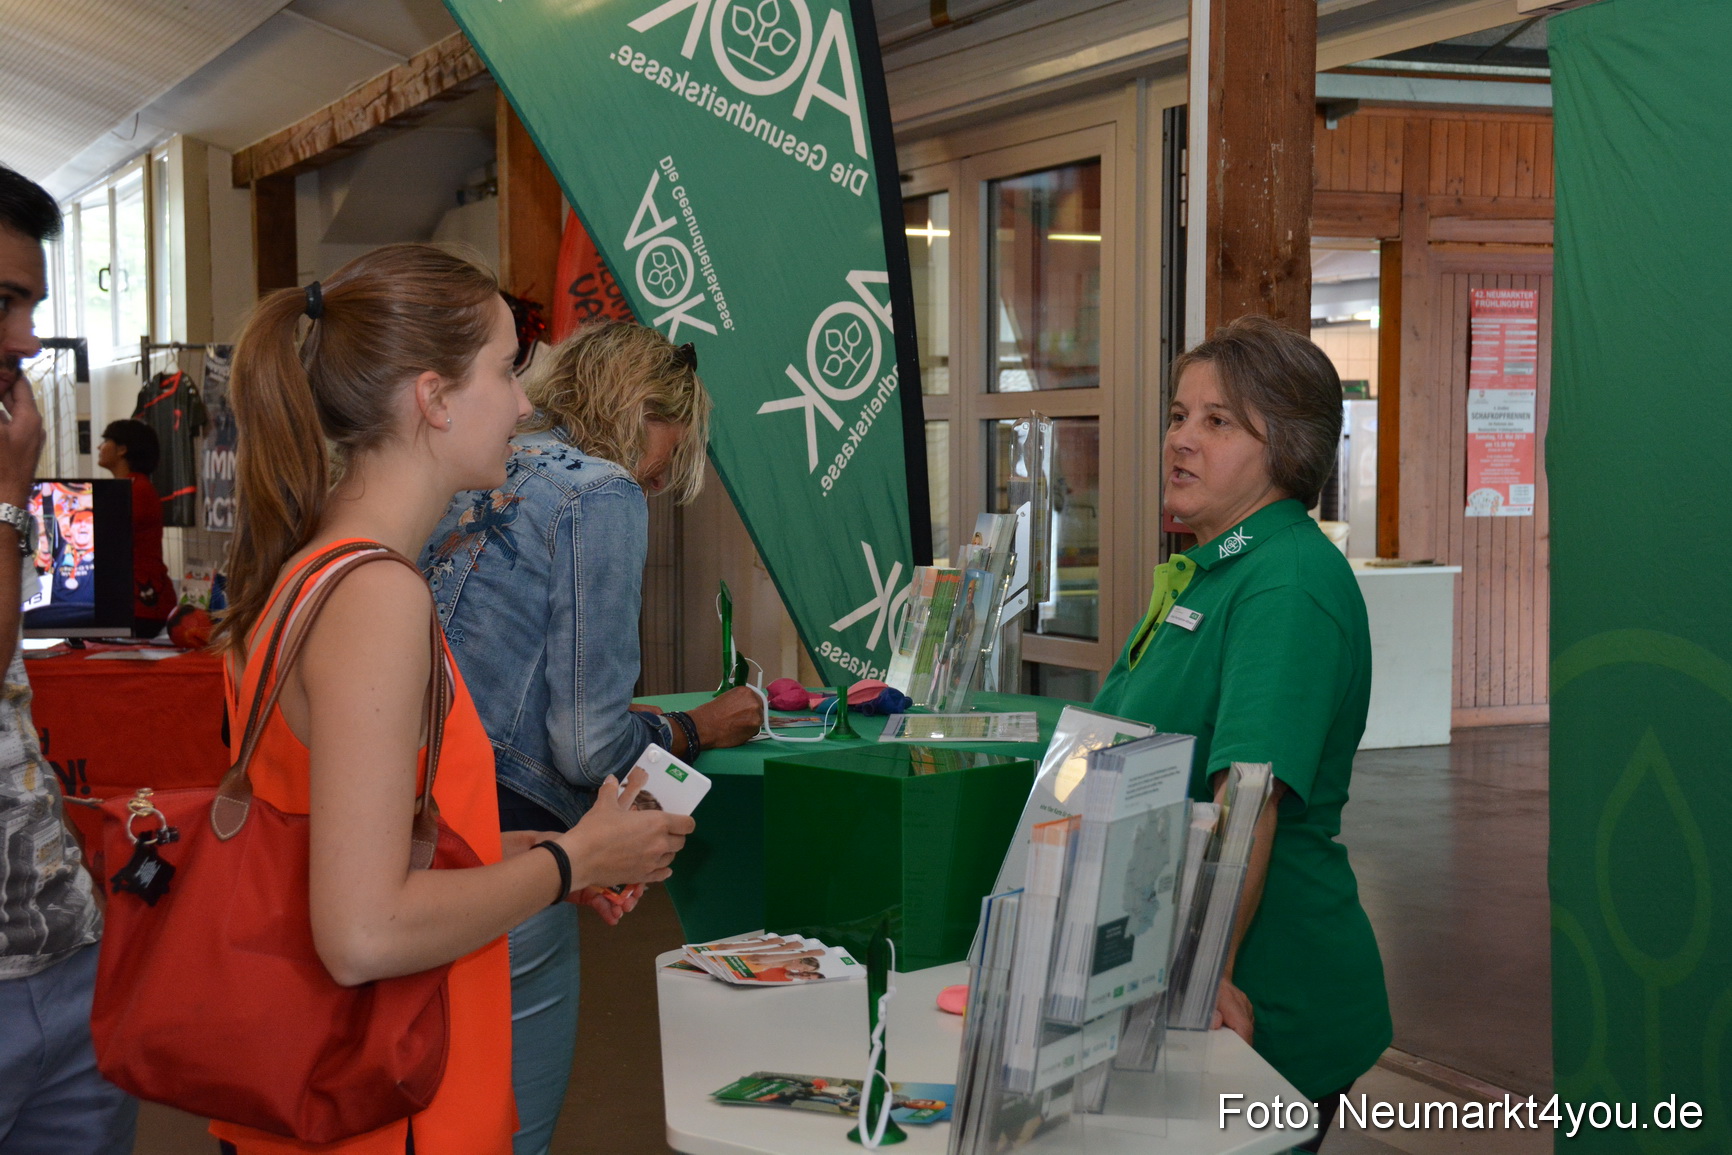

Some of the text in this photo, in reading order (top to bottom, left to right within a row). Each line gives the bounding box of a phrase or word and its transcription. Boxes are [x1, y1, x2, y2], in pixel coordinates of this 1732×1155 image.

[1486, 290, 1534, 299] NEUMARKTER
[1475, 298, 1534, 308] FRÜHLINGSFEST
[1471, 412, 1531, 420] SCHAFKOPFRENNEN
[1218, 526, 1254, 559] AOK
